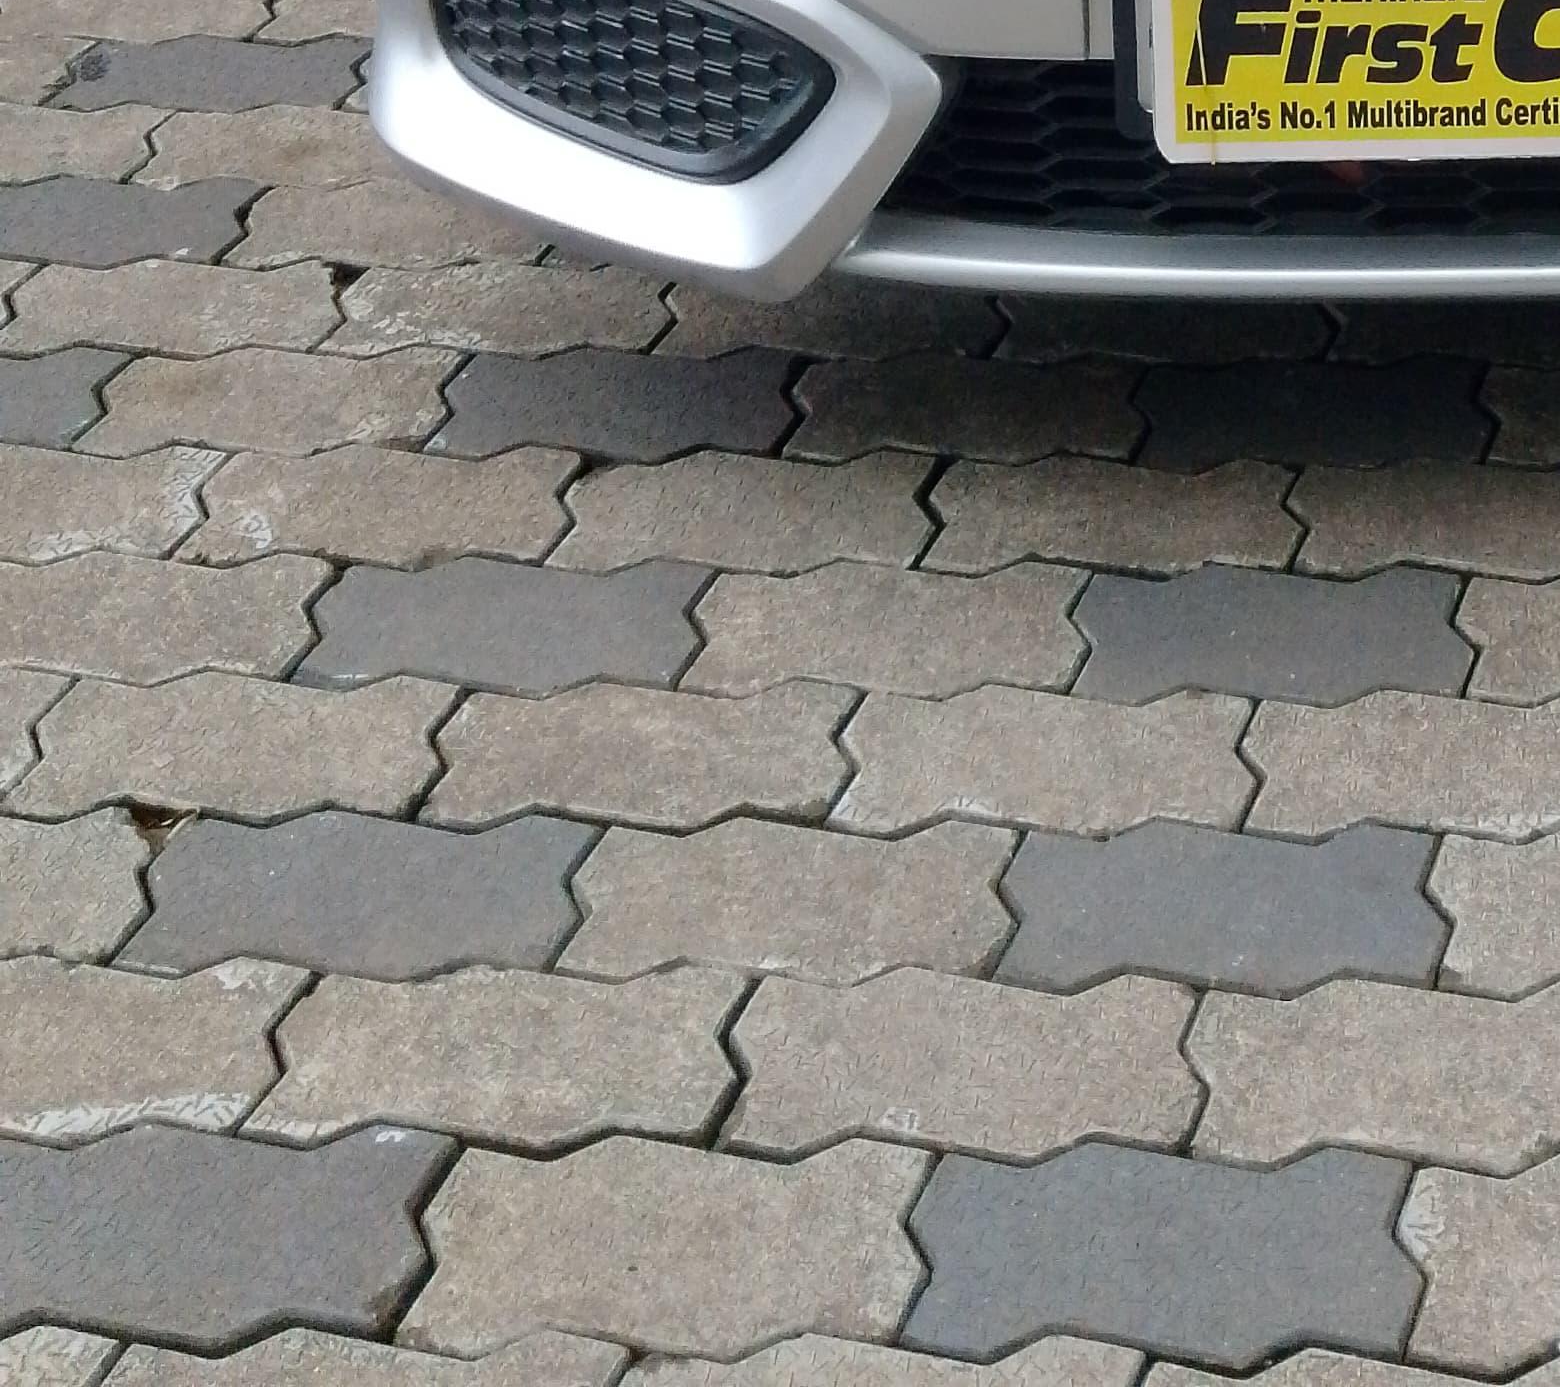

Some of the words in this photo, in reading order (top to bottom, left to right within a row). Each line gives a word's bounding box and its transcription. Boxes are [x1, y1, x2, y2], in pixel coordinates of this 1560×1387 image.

[1186, 102, 1271, 132] India's
[1280, 100, 1336, 129] No.1
[1348, 98, 1486, 128] Multibrand
